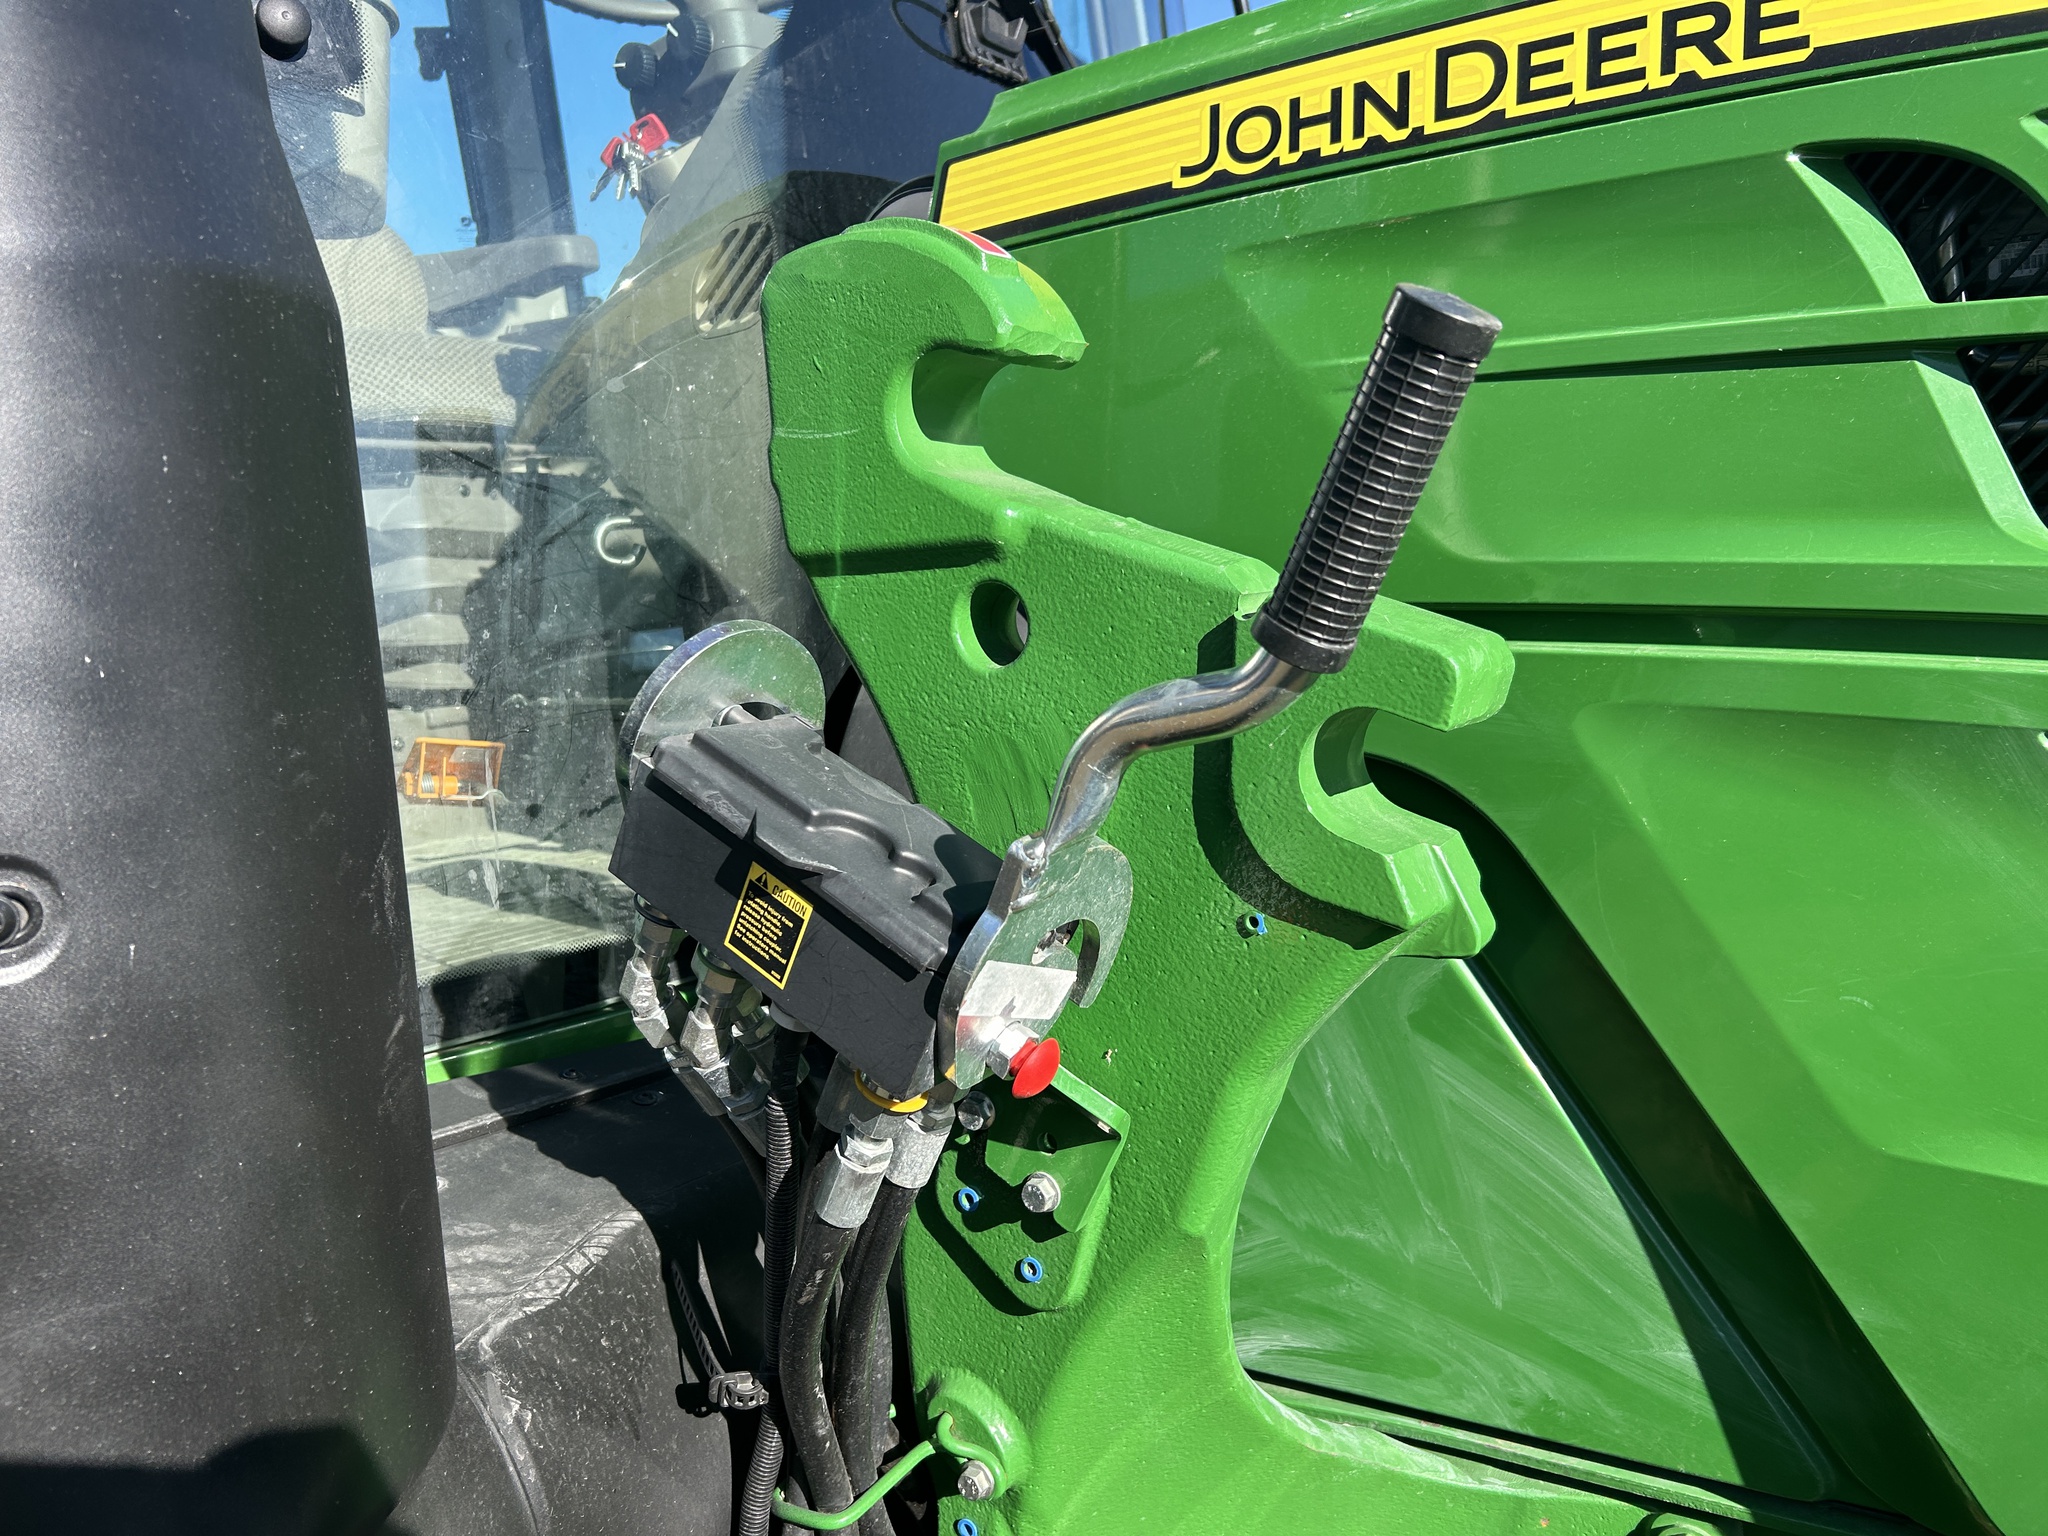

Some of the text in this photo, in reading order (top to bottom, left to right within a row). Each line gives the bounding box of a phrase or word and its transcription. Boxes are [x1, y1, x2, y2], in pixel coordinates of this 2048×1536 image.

[1180, 0, 1811, 178] JOHN DEERE
[772, 885, 808, 917] CAUTION
